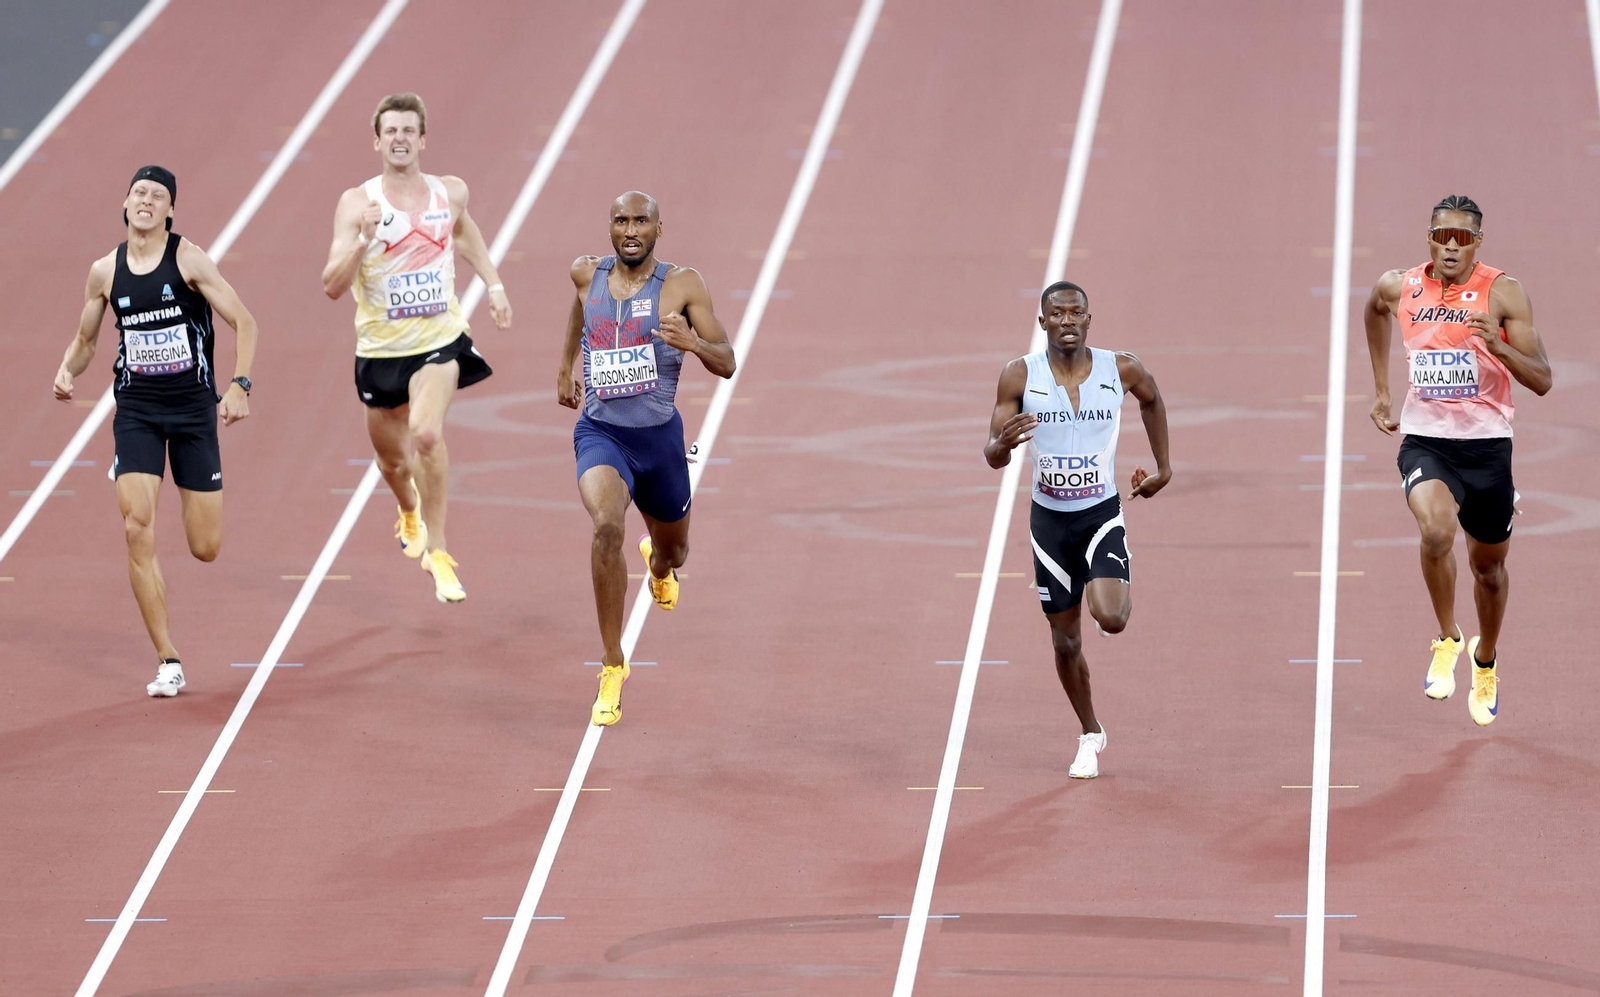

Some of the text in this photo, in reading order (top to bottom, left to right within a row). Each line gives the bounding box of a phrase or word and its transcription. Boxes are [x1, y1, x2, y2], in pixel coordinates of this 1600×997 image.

[401, 270, 442, 286] TDK
[391, 287, 443, 306] DOOM
[121, 305, 183, 327] ARGENTINA
[1411, 307, 1469, 323] JAPAN
[139, 327, 182, 346] TDK
[129, 345, 188, 363] LARREGINA
[605, 346, 650, 365] TDK
[1427, 352, 1472, 366] TDK
[593, 364, 655, 386] HUDSON-SMITH
[1413, 369, 1475, 385] NAKAJIMA
[1052, 455, 1099, 470] TDK
[1040, 470, 1099, 487] NDORI
